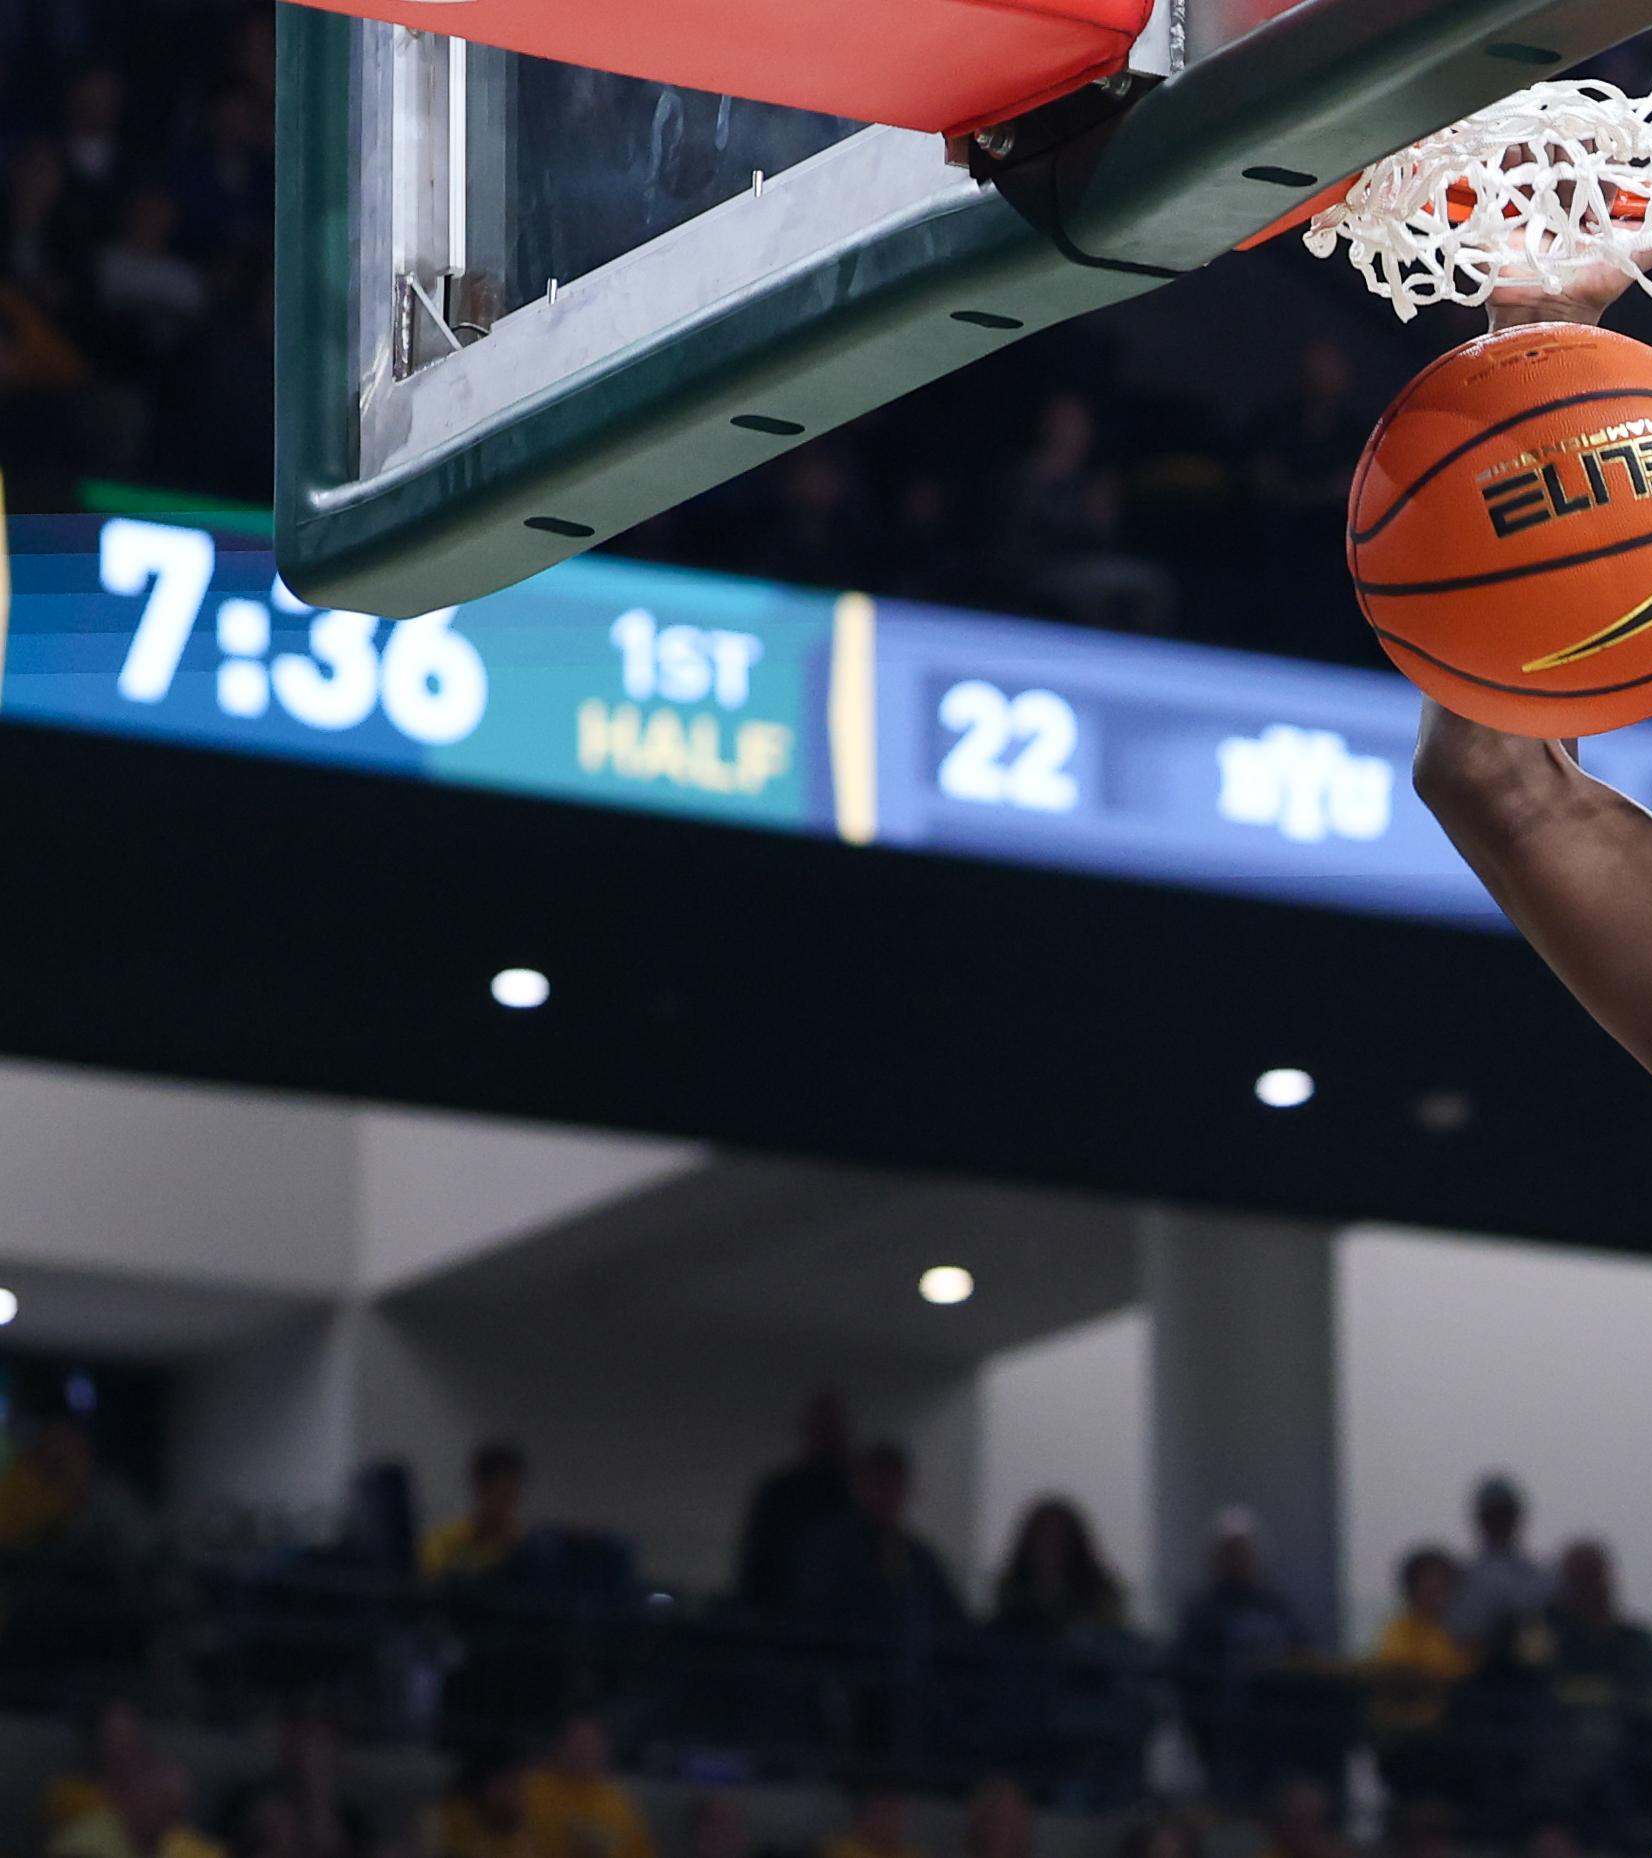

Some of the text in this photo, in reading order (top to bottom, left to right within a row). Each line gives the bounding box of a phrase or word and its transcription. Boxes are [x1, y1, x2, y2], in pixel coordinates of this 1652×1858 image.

[610, 607, 764, 710] 1ST
[577, 697, 796, 795] HALF
[937, 678, 1080, 813] 22
